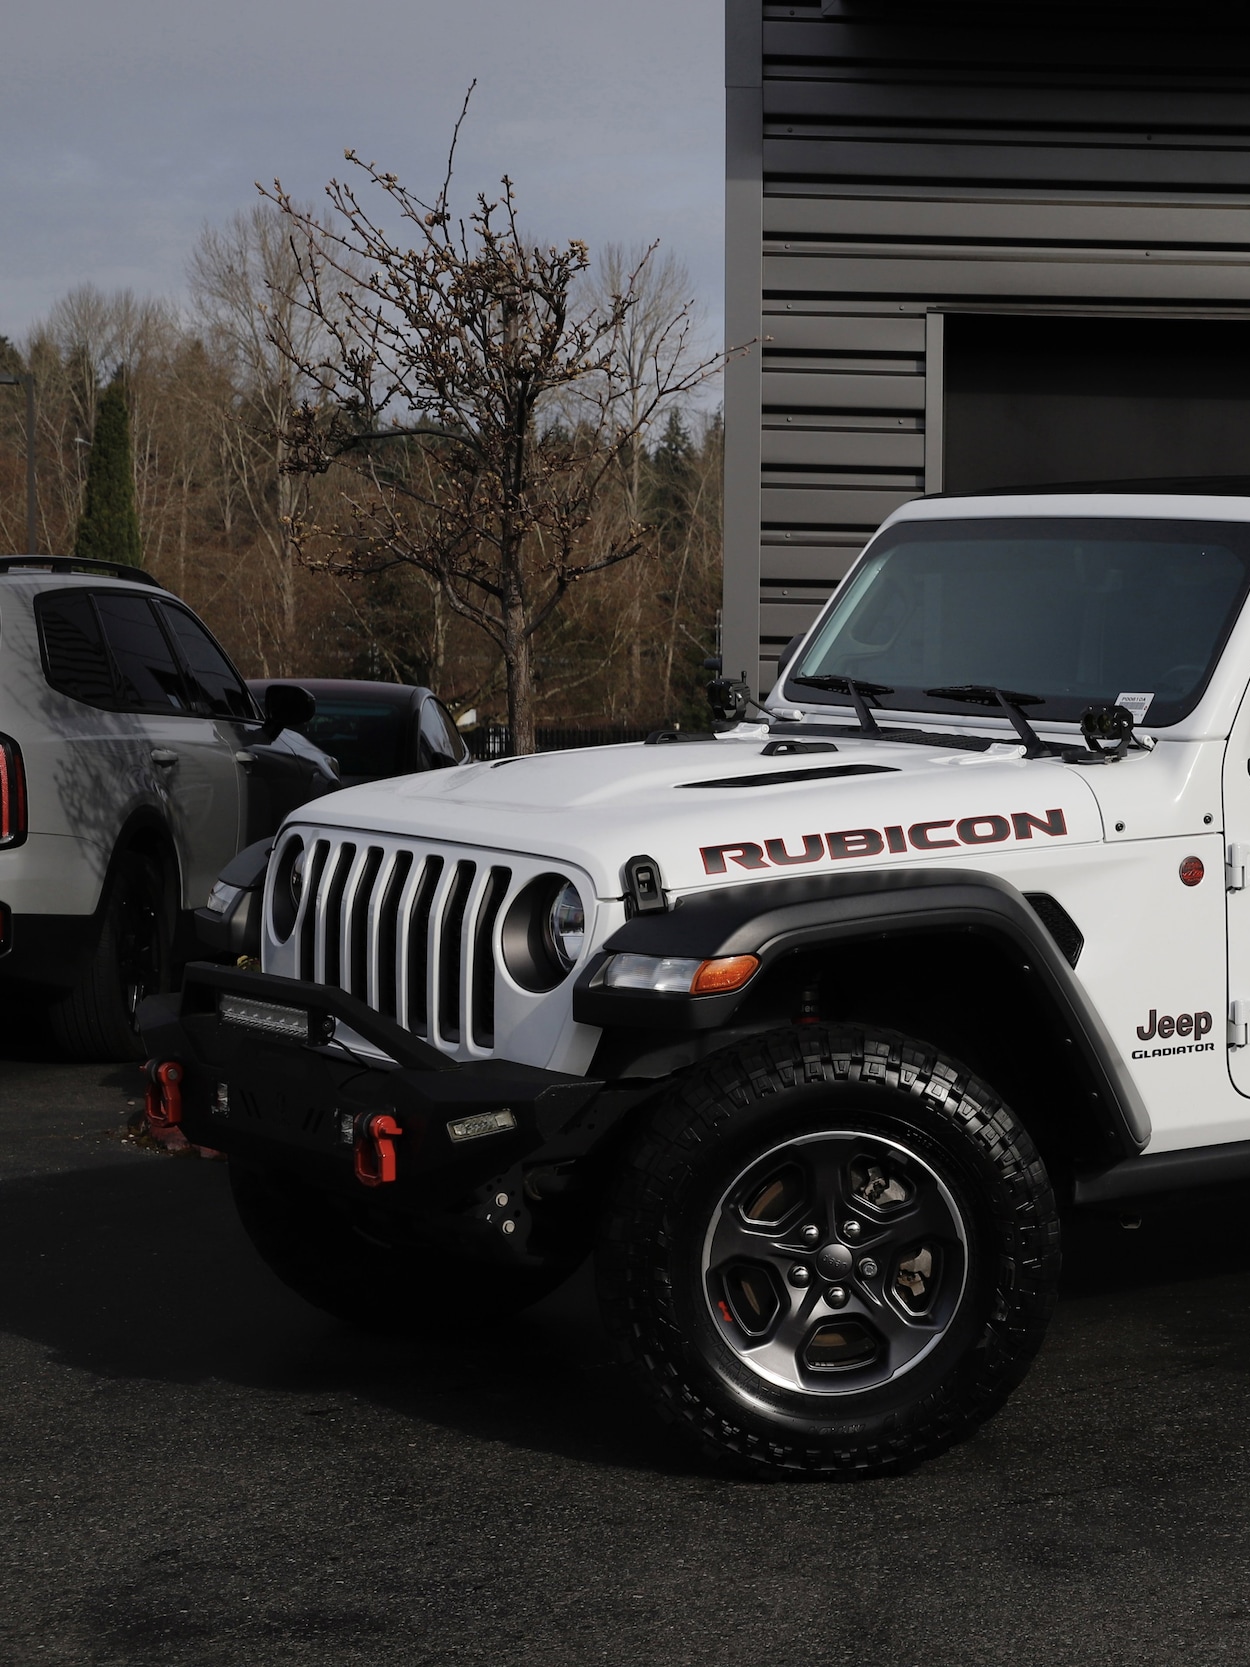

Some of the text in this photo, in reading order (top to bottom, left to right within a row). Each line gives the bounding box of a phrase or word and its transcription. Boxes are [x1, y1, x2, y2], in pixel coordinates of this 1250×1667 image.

[699, 808, 1067, 874] RUBICON
[1136, 1009, 1213, 1041] Jeep
[1132, 1042, 1215, 1060] GLADIATOR
